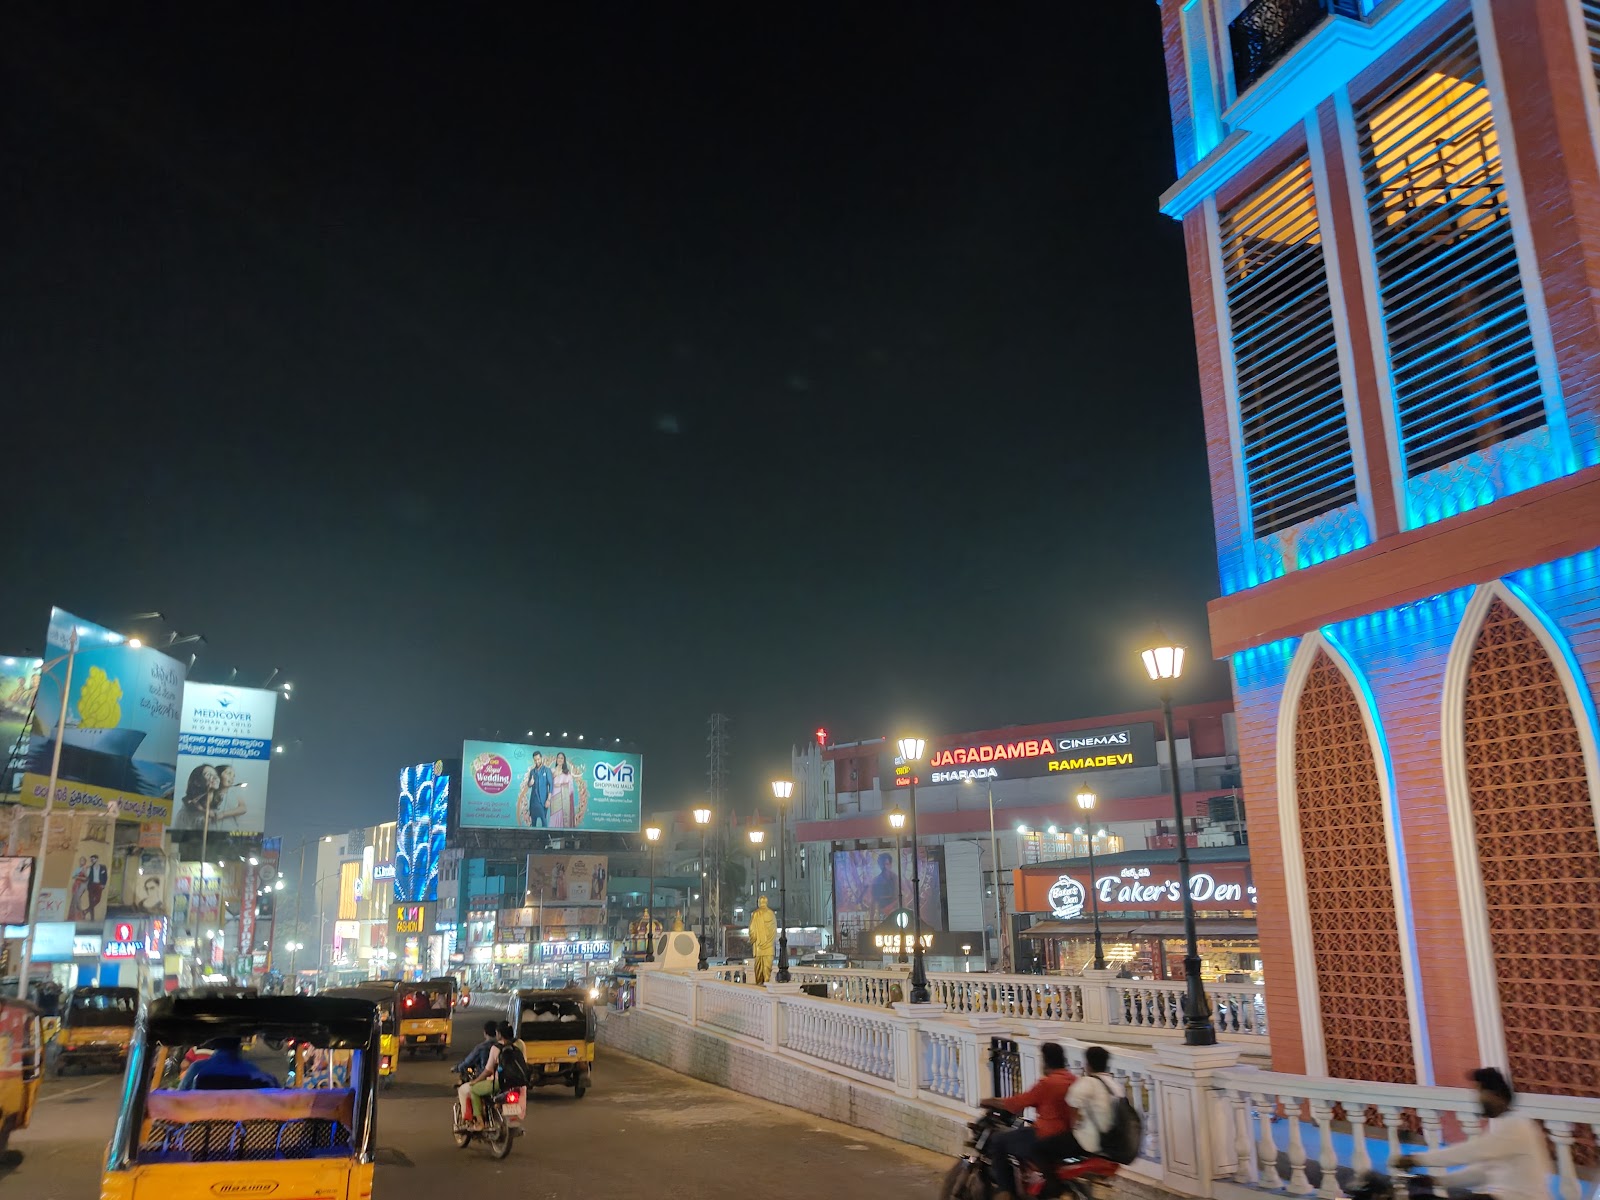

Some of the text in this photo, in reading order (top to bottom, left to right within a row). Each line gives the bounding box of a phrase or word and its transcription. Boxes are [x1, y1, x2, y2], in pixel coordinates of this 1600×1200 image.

[193, 708, 252, 721] MEDICOVER
[191, 725, 251, 734] HOSPITALS
[930, 739, 1055, 767] JAGADAMBA
[1058, 733, 1128, 750] CINEMAS
[1048, 753, 1133, 772] RAMADEVI
[594, 760, 634, 783] CMR
[931, 767, 998, 783] SHARADA
[476, 772, 510, 785] Wedding
[594, 782, 619, 790] SHOPPING
[1095, 873, 1242, 903] Baker's Den
[1062, 895, 1079, 904] Den
[397, 906, 418, 921] KLM
[396, 921, 418, 933] FASHION
[875, 934, 902, 947] BUS
[542, 942, 611, 955] HI TECH SHOES
